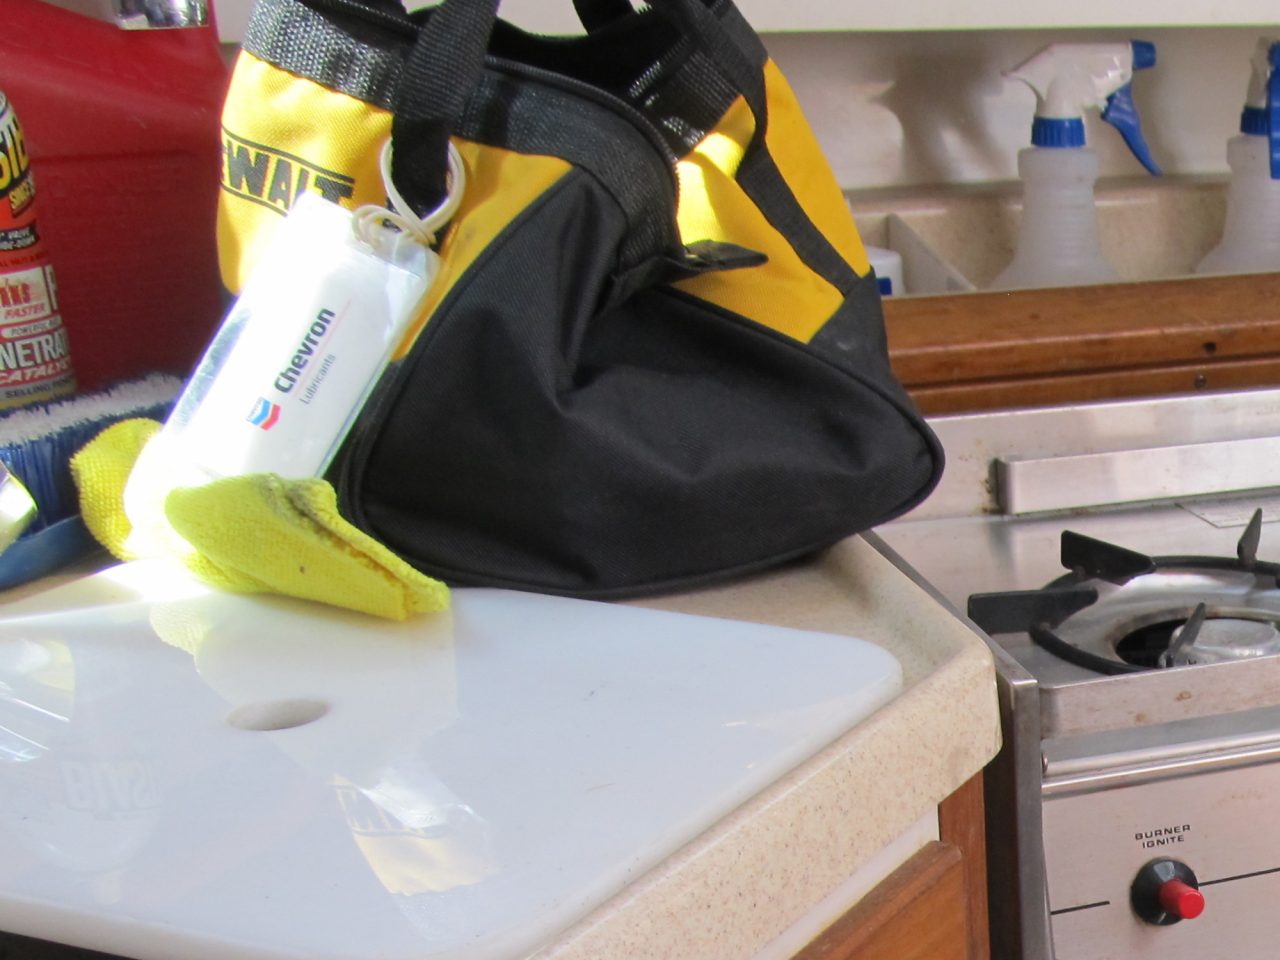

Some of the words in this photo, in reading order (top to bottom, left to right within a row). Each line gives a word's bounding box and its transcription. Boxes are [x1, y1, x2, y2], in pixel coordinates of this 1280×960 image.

[274, 308, 336, 393] Chevron
[299, 354, 336, 404] Lubricants
[1135, 824, 1191, 841] BURNER
[1142, 835, 1185, 849] IGNITE
